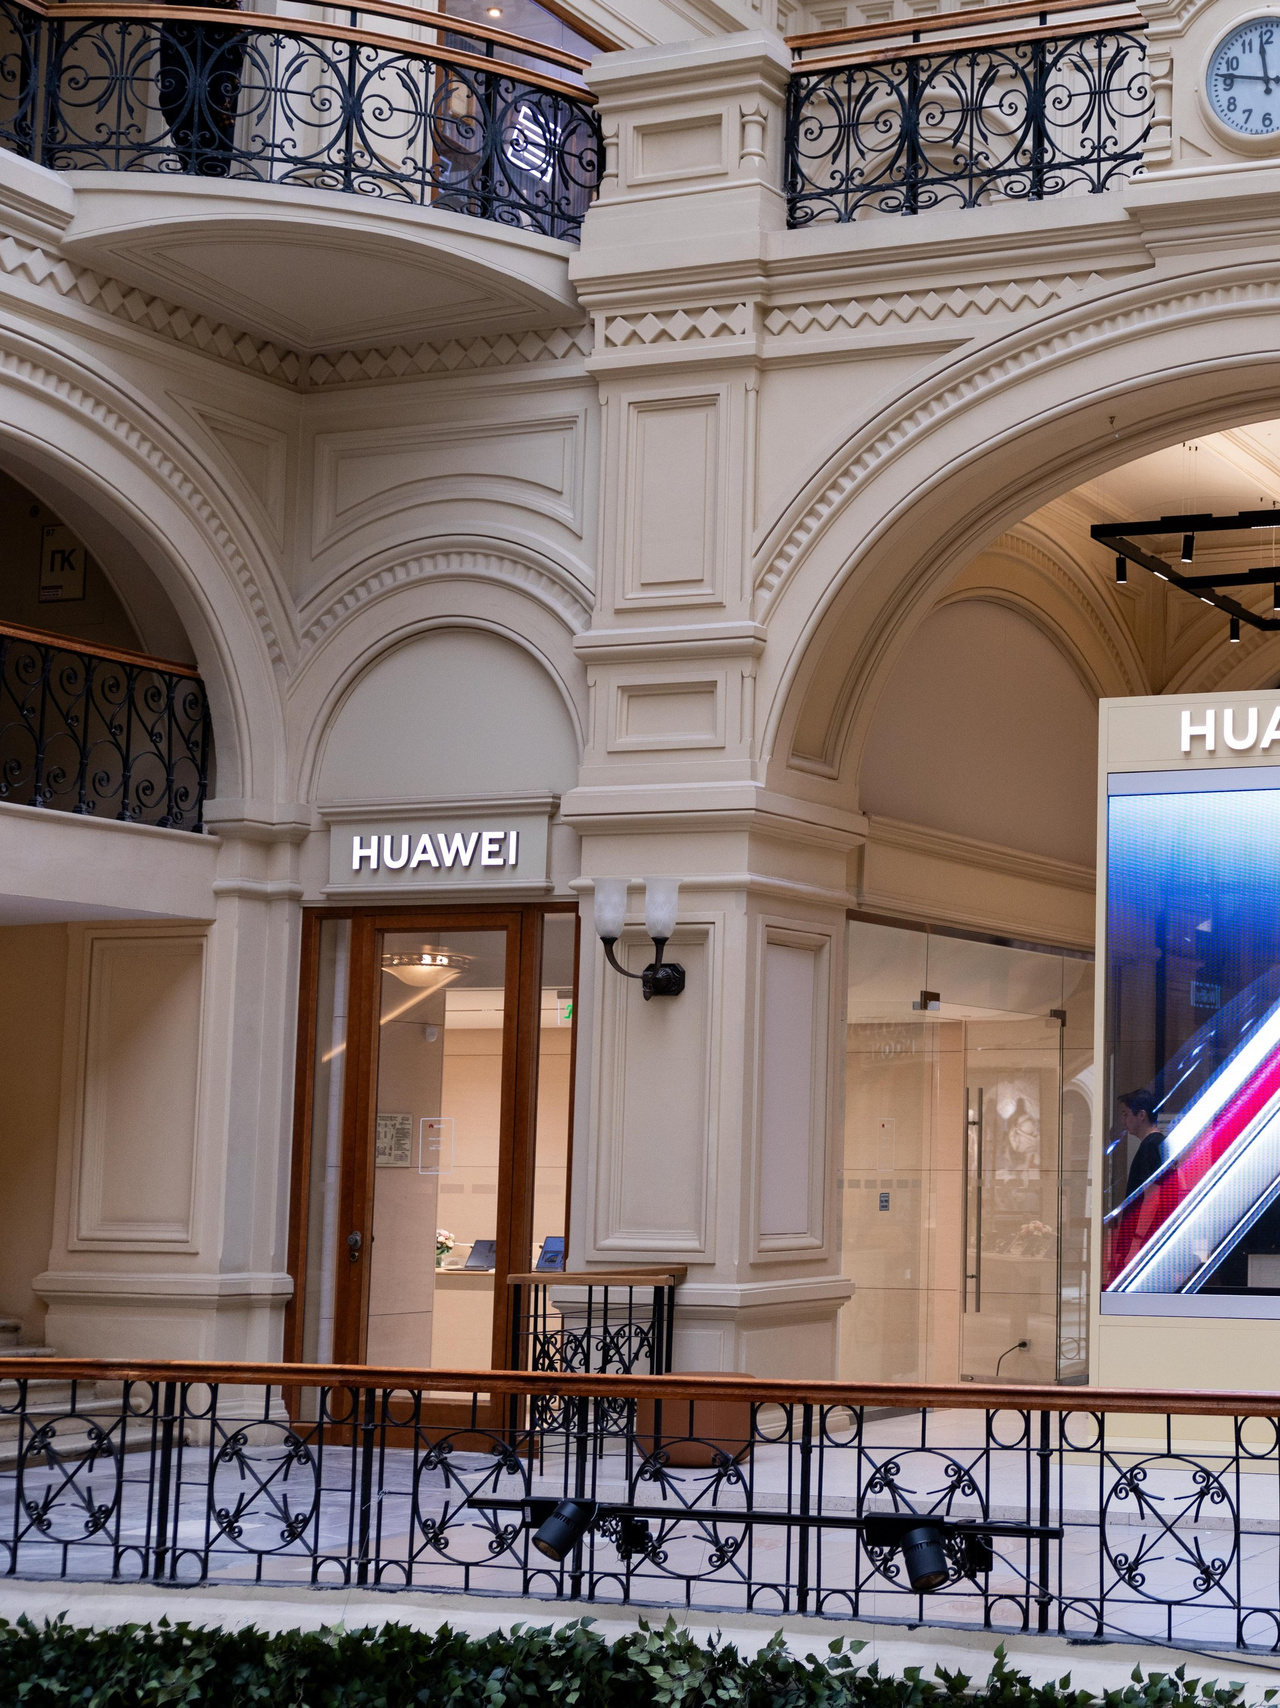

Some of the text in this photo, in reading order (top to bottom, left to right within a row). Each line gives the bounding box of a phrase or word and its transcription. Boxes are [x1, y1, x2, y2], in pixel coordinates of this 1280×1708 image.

[1241, 38, 1253, 54] 11
[1225, 55, 1240, 72] 10
[1222, 75, 1235, 92] 9
[1226, 96, 1238, 113] 8
[1242, 108, 1253, 125] 7
[1261, 112, 1273, 128] 6
[50, 548, 77, 572] ПК
[352, 830, 519, 870] HUAWEI
